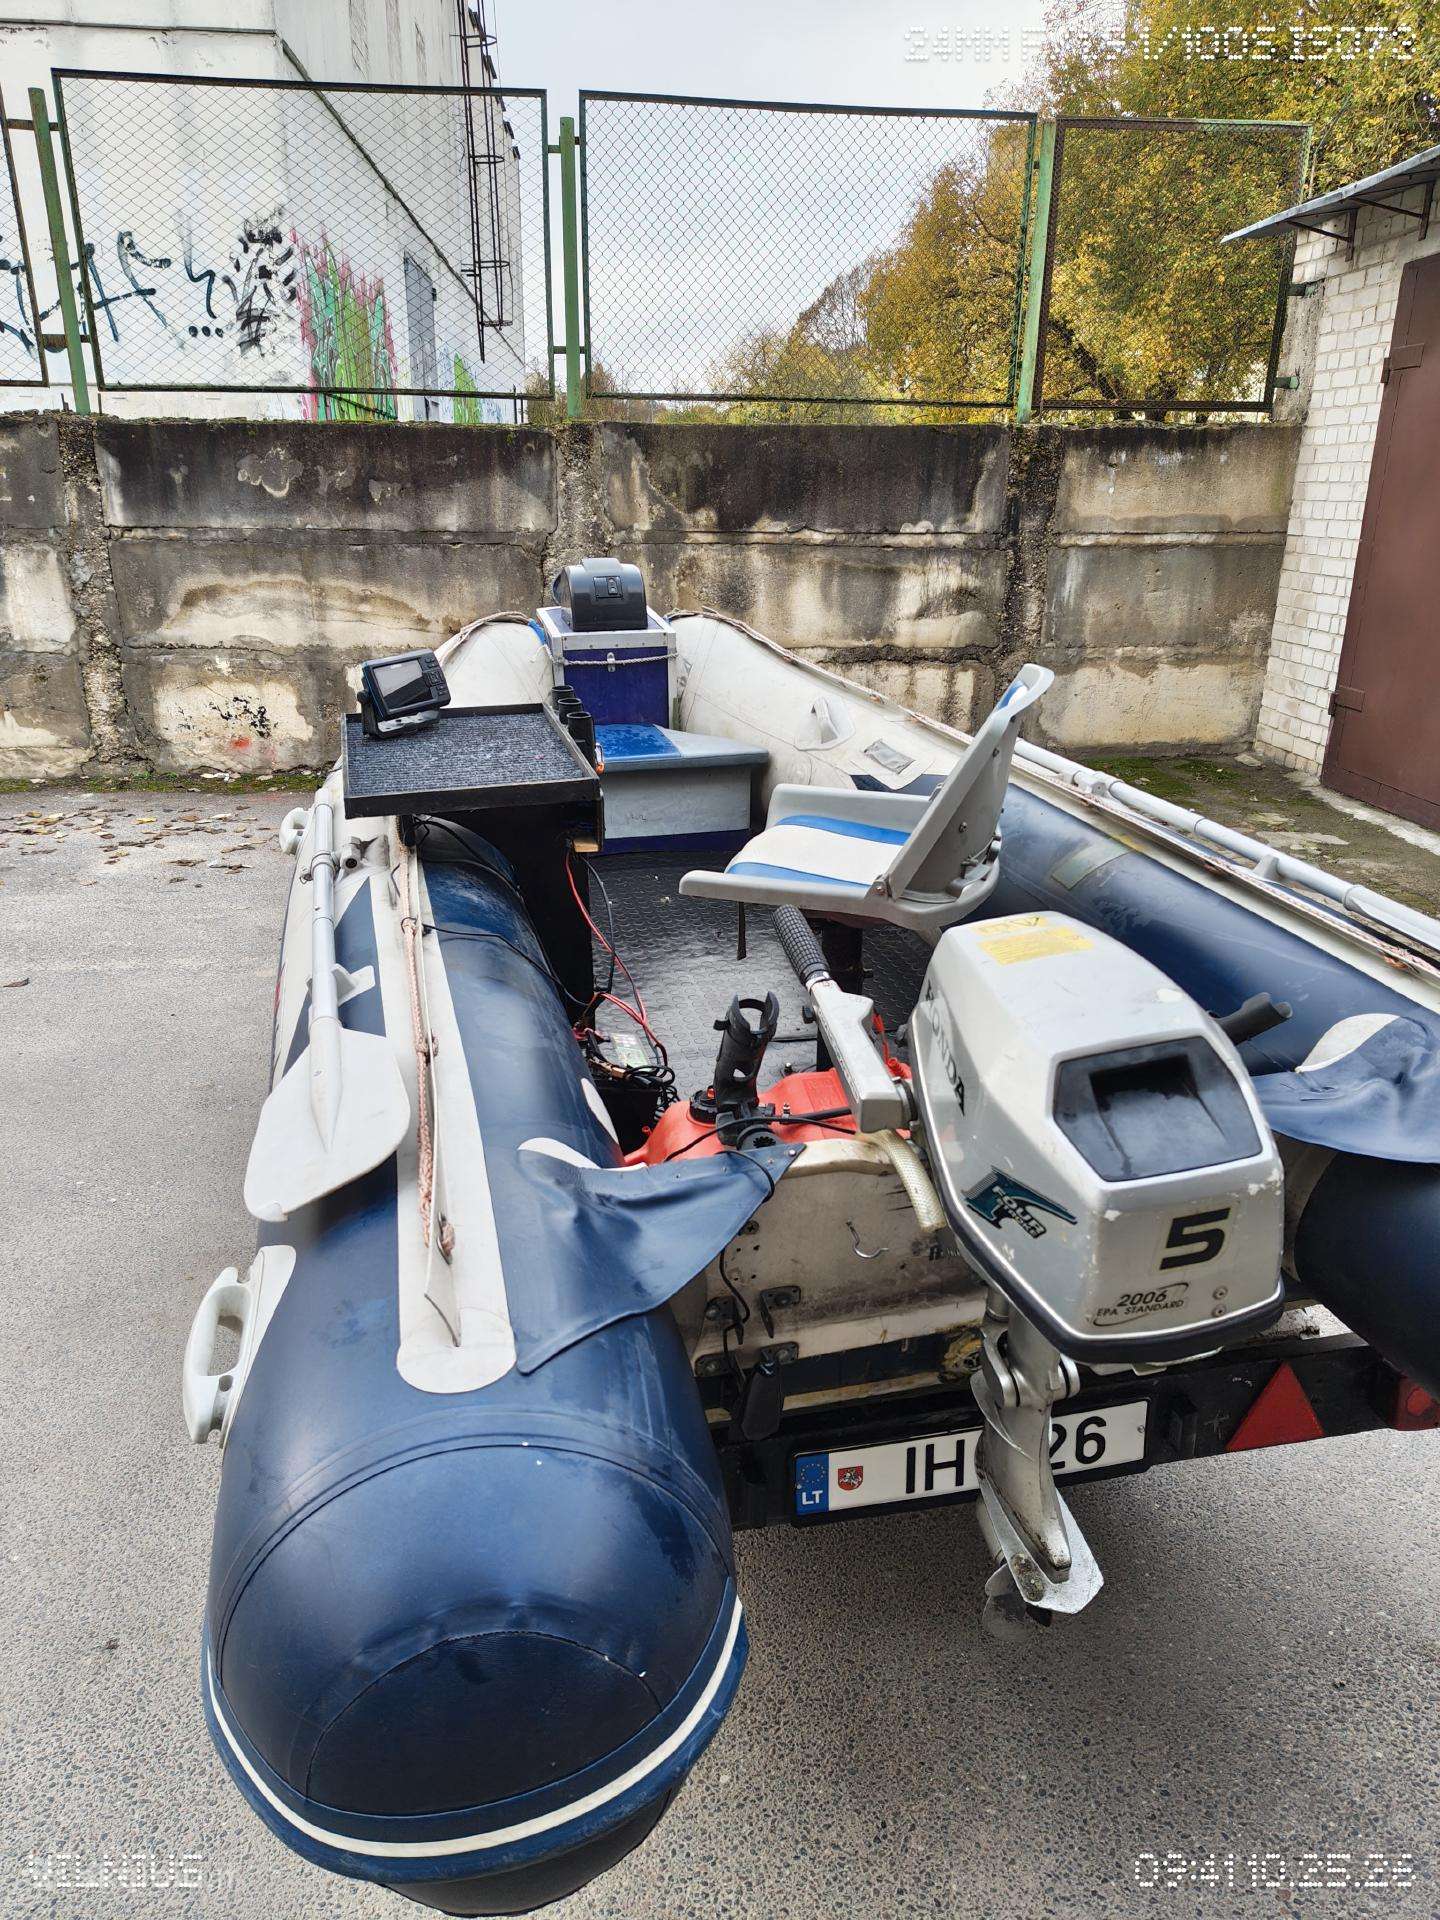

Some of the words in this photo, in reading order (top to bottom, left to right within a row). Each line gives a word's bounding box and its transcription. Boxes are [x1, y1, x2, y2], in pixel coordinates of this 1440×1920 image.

[991, 1185, 1046, 1233] FOUR
[1159, 1207, 1232, 1271] 5
[1096, 1307, 1119, 1317] EPA
[1123, 1300, 1184, 1316] STANDARD
[1116, 1290, 1169, 1308] 2006
[904, 1438, 965, 1494] IH
[801, 1489, 824, 1506] LT
